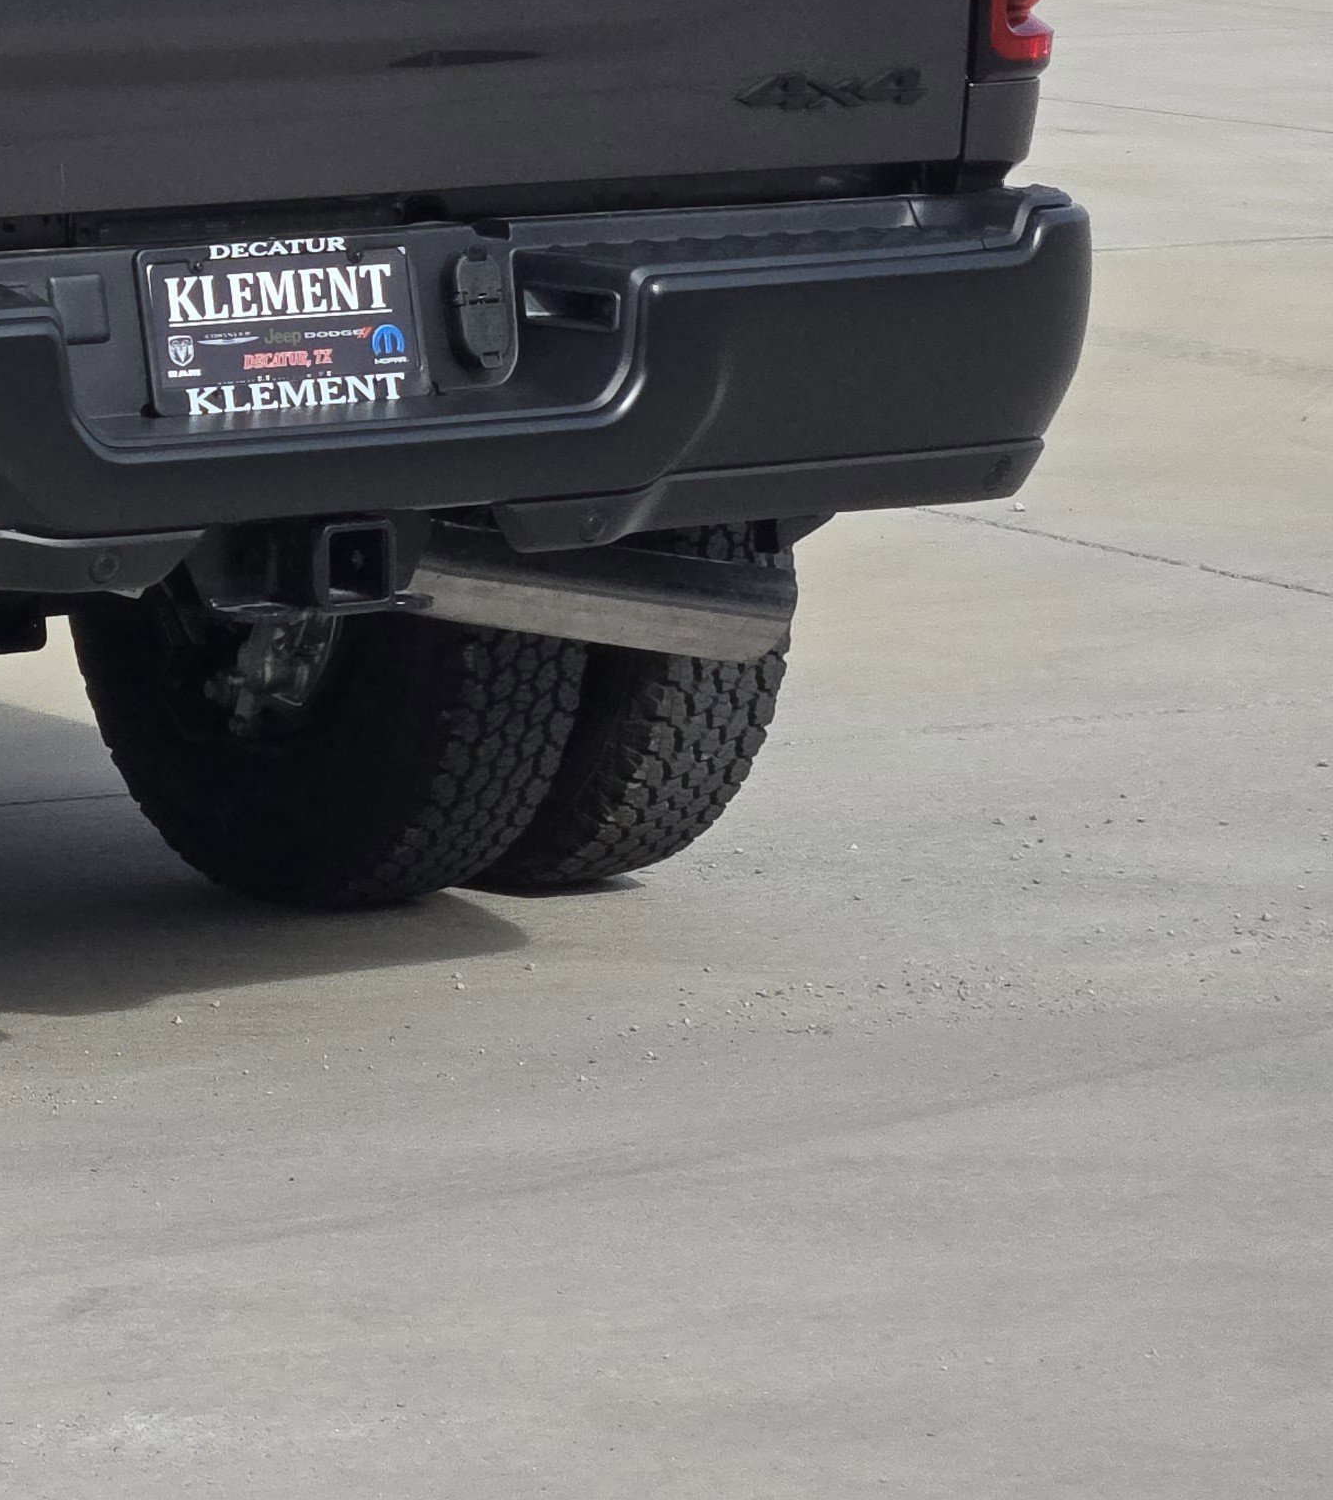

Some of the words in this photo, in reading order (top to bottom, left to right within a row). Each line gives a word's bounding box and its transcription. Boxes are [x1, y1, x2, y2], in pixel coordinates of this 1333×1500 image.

[209, 237, 347, 260] DECATUR
[164, 264, 392, 322] KLEMENT
[264, 328, 301, 346] Jeep
[304, 329, 364, 339] DODGE
[313, 349, 333, 364] TX
[186, 372, 405, 415] KLEMENT
